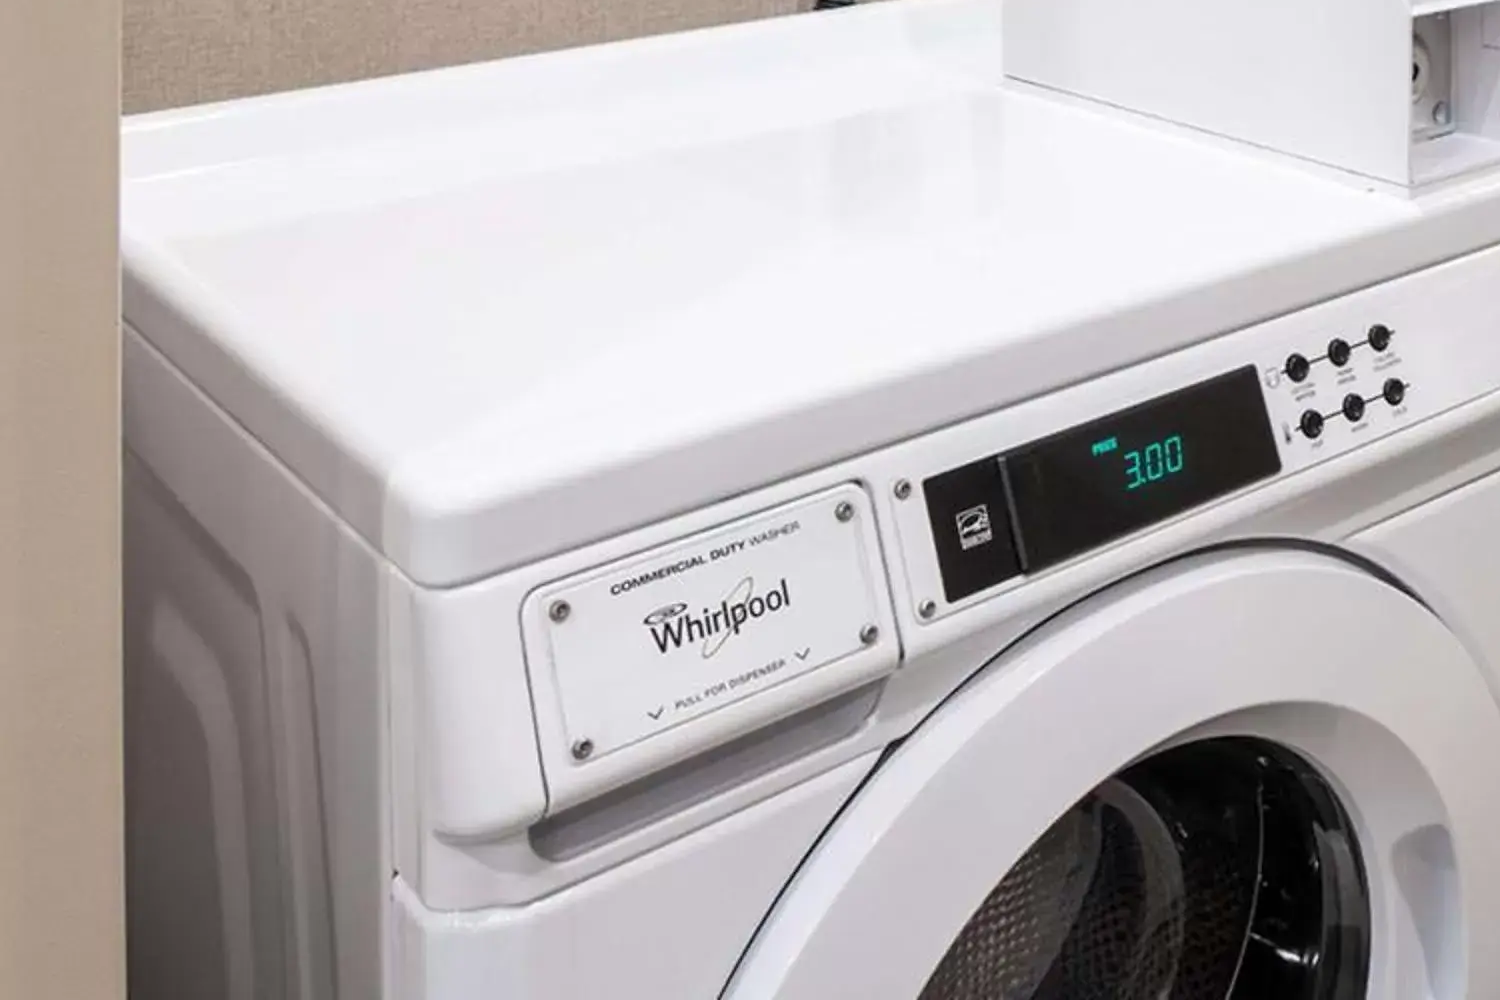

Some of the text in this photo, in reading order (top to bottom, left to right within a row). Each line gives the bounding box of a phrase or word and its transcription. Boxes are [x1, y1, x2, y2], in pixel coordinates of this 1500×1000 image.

[1124, 436, 1183, 489] 3.00
[610, 520, 801, 596] COMMERCIAL DUTY WASHER
[650, 577, 790, 654] Whirlpool
[704, 682, 727, 698] FOR
